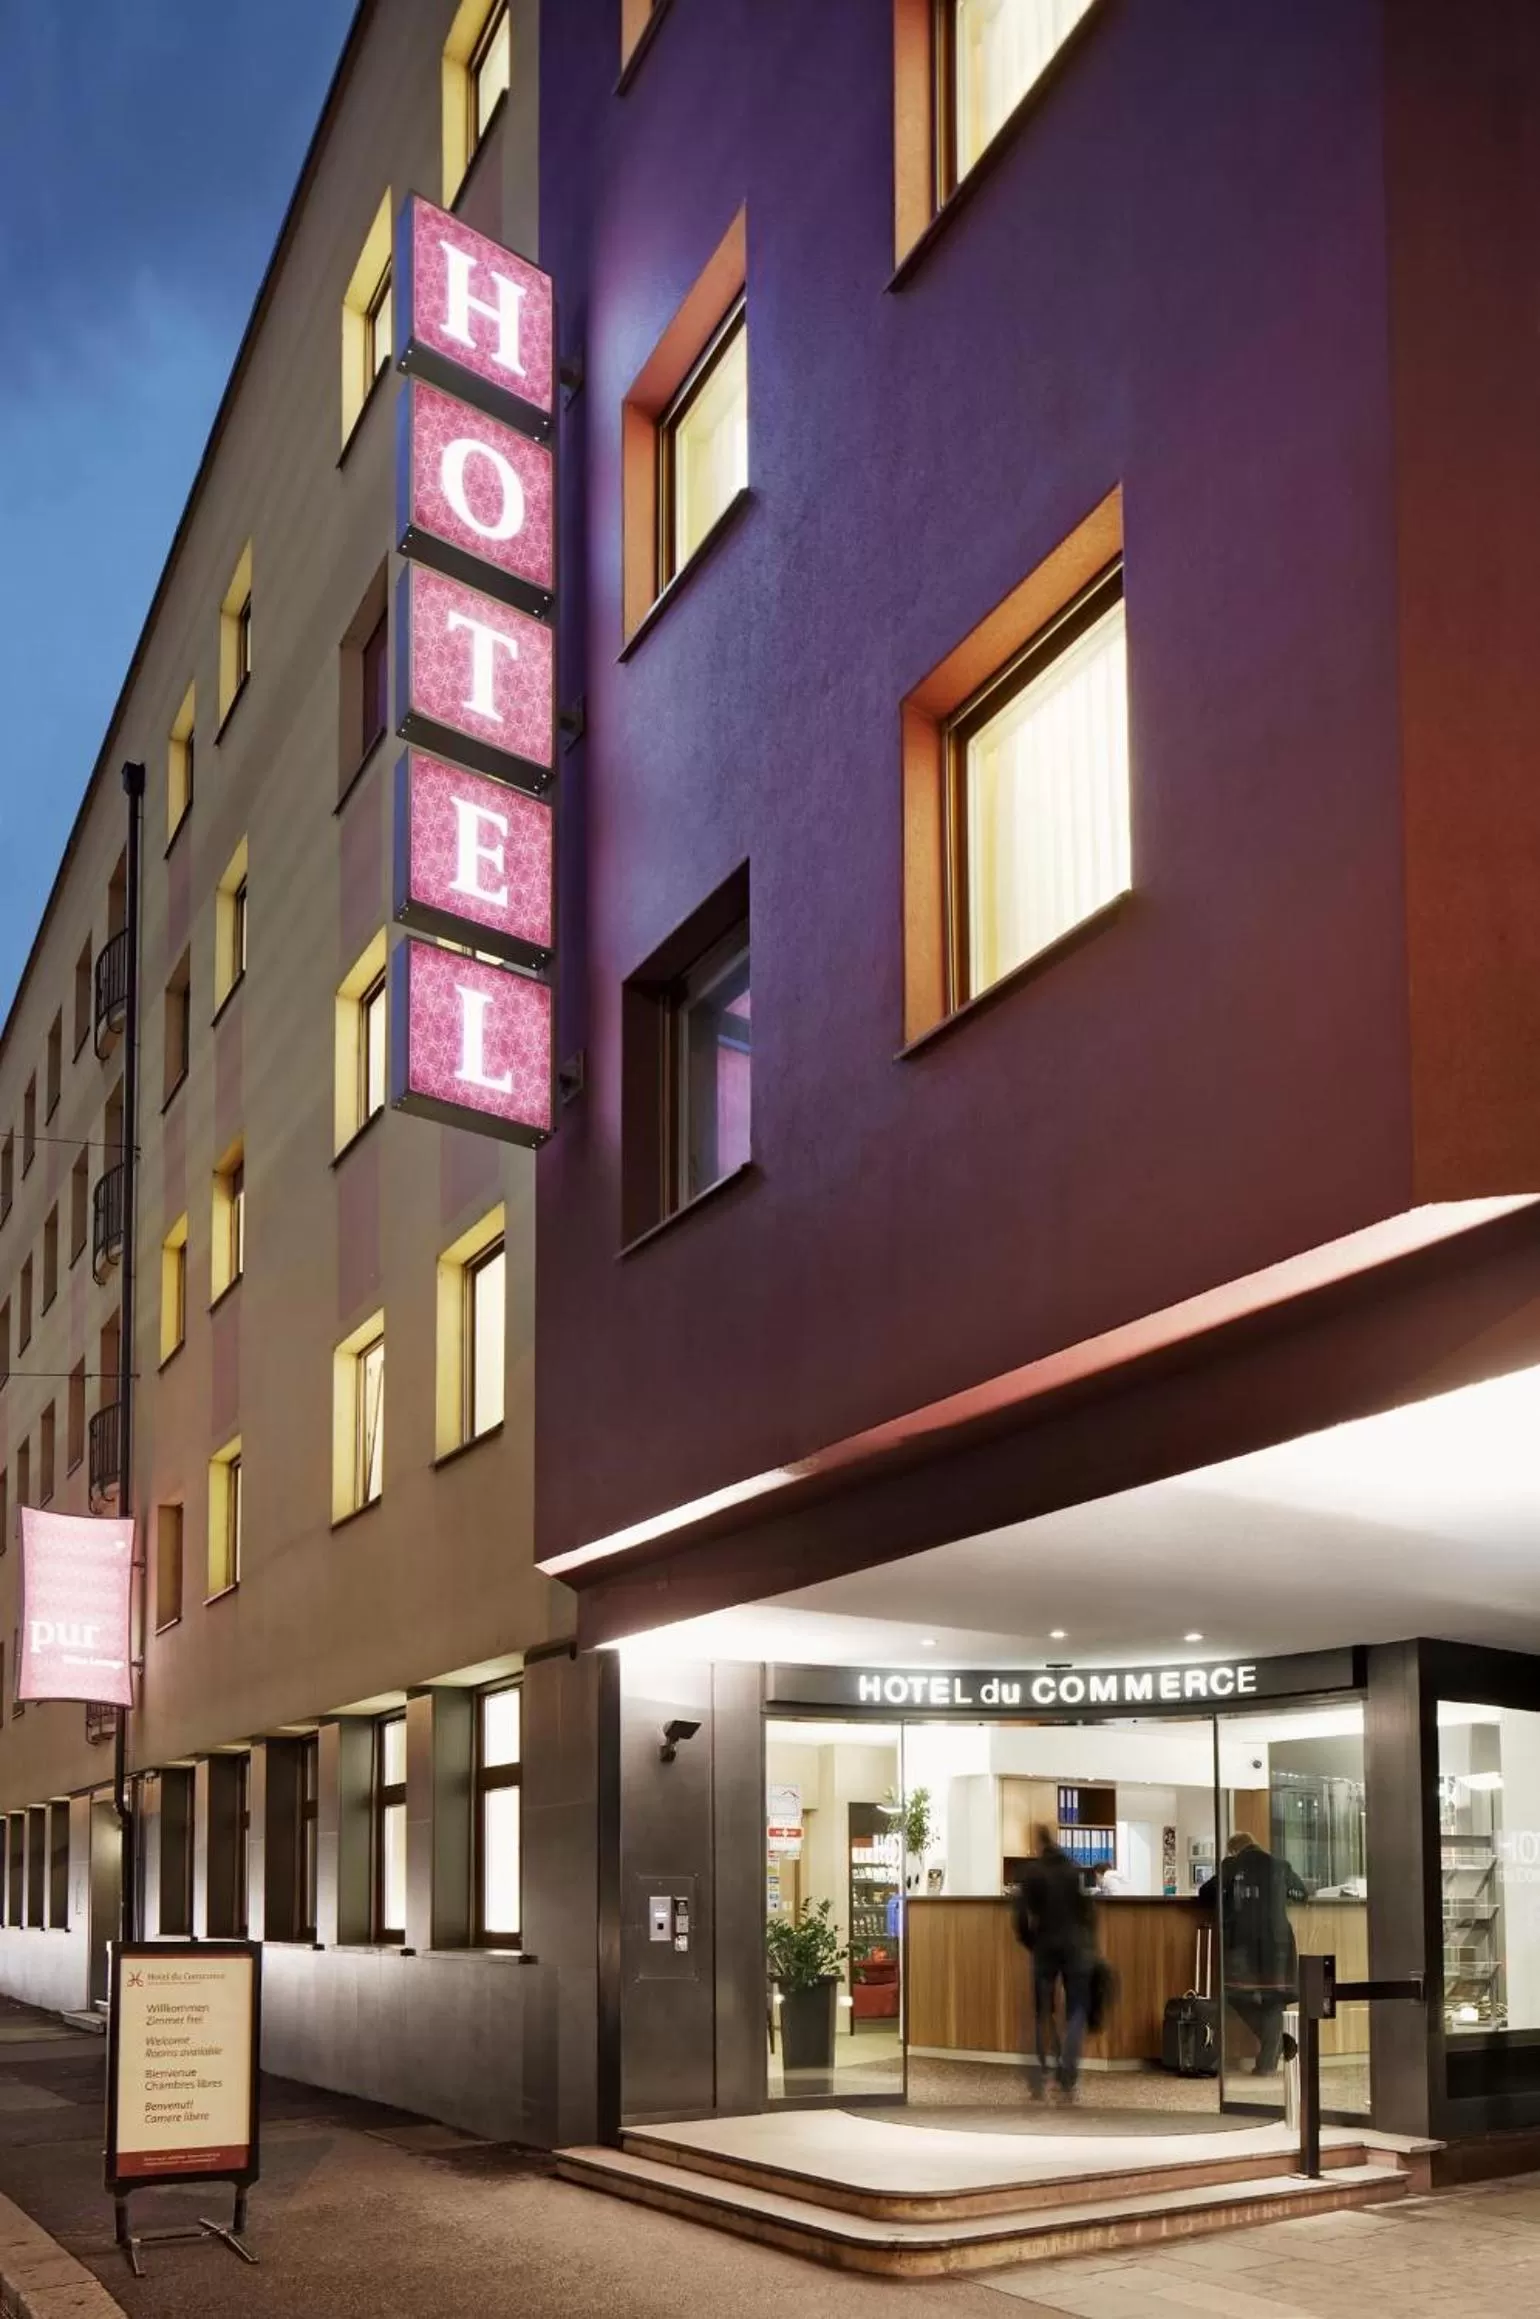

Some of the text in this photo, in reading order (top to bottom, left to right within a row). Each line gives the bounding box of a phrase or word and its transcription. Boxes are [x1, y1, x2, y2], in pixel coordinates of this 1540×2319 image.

[439, 239, 527, 1094] HOTEL
[28, 1620, 100, 1653] pur
[858, 1666, 1258, 1706] HOTEL du COMMERCE
[146, 2003, 210, 2013] Willkommen
[146, 2015, 184, 2026] Zimmer
[146, 2036, 190, 2046] Welcome
[145, 2069, 197, 2079] Bienvenue
[144, 2080, 195, 2091] Chambres
[144, 2113, 182, 2124] Camere
